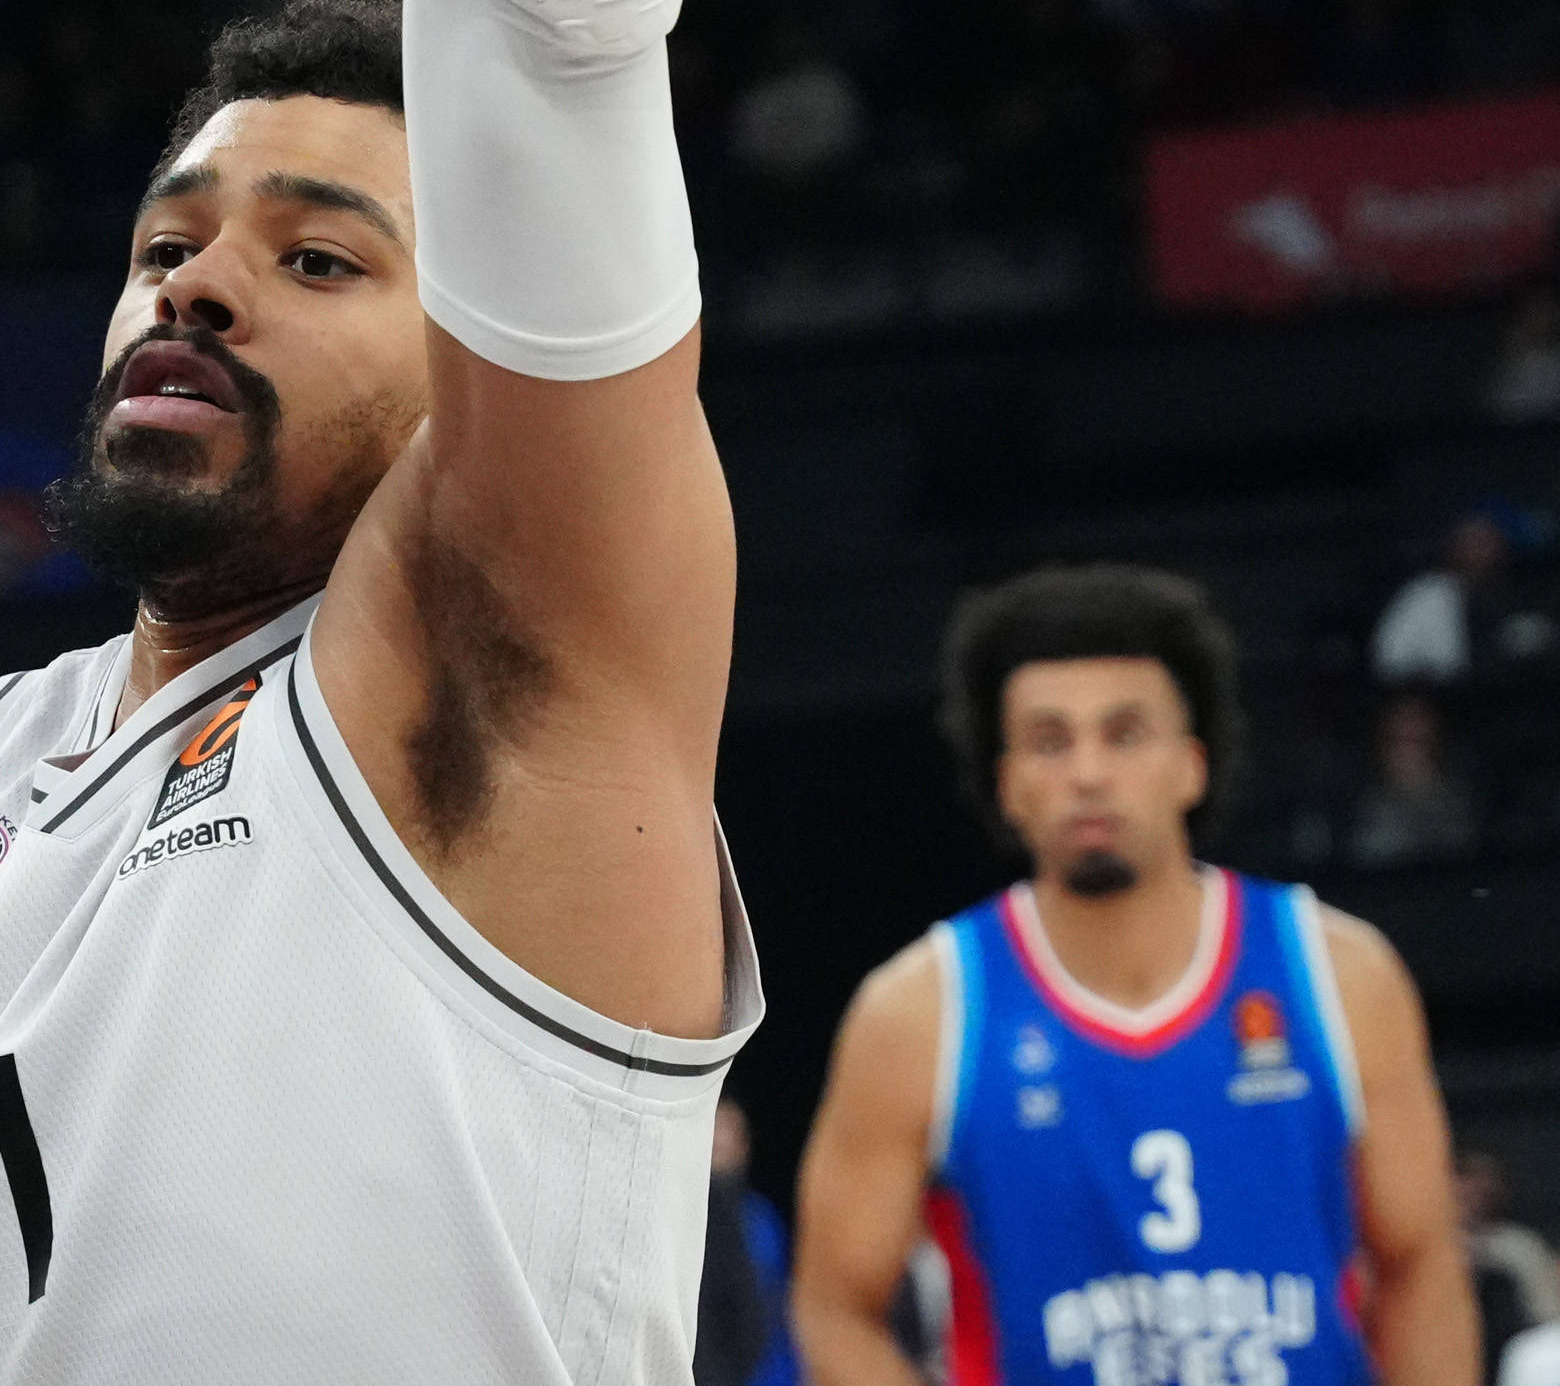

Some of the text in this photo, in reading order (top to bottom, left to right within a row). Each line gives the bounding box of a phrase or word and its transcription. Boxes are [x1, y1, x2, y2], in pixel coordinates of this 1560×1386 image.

[160, 764, 227, 811] AIRLINES
[168, 747, 233, 795] TURKISH
[1130, 1128, 1202, 1254] 3
